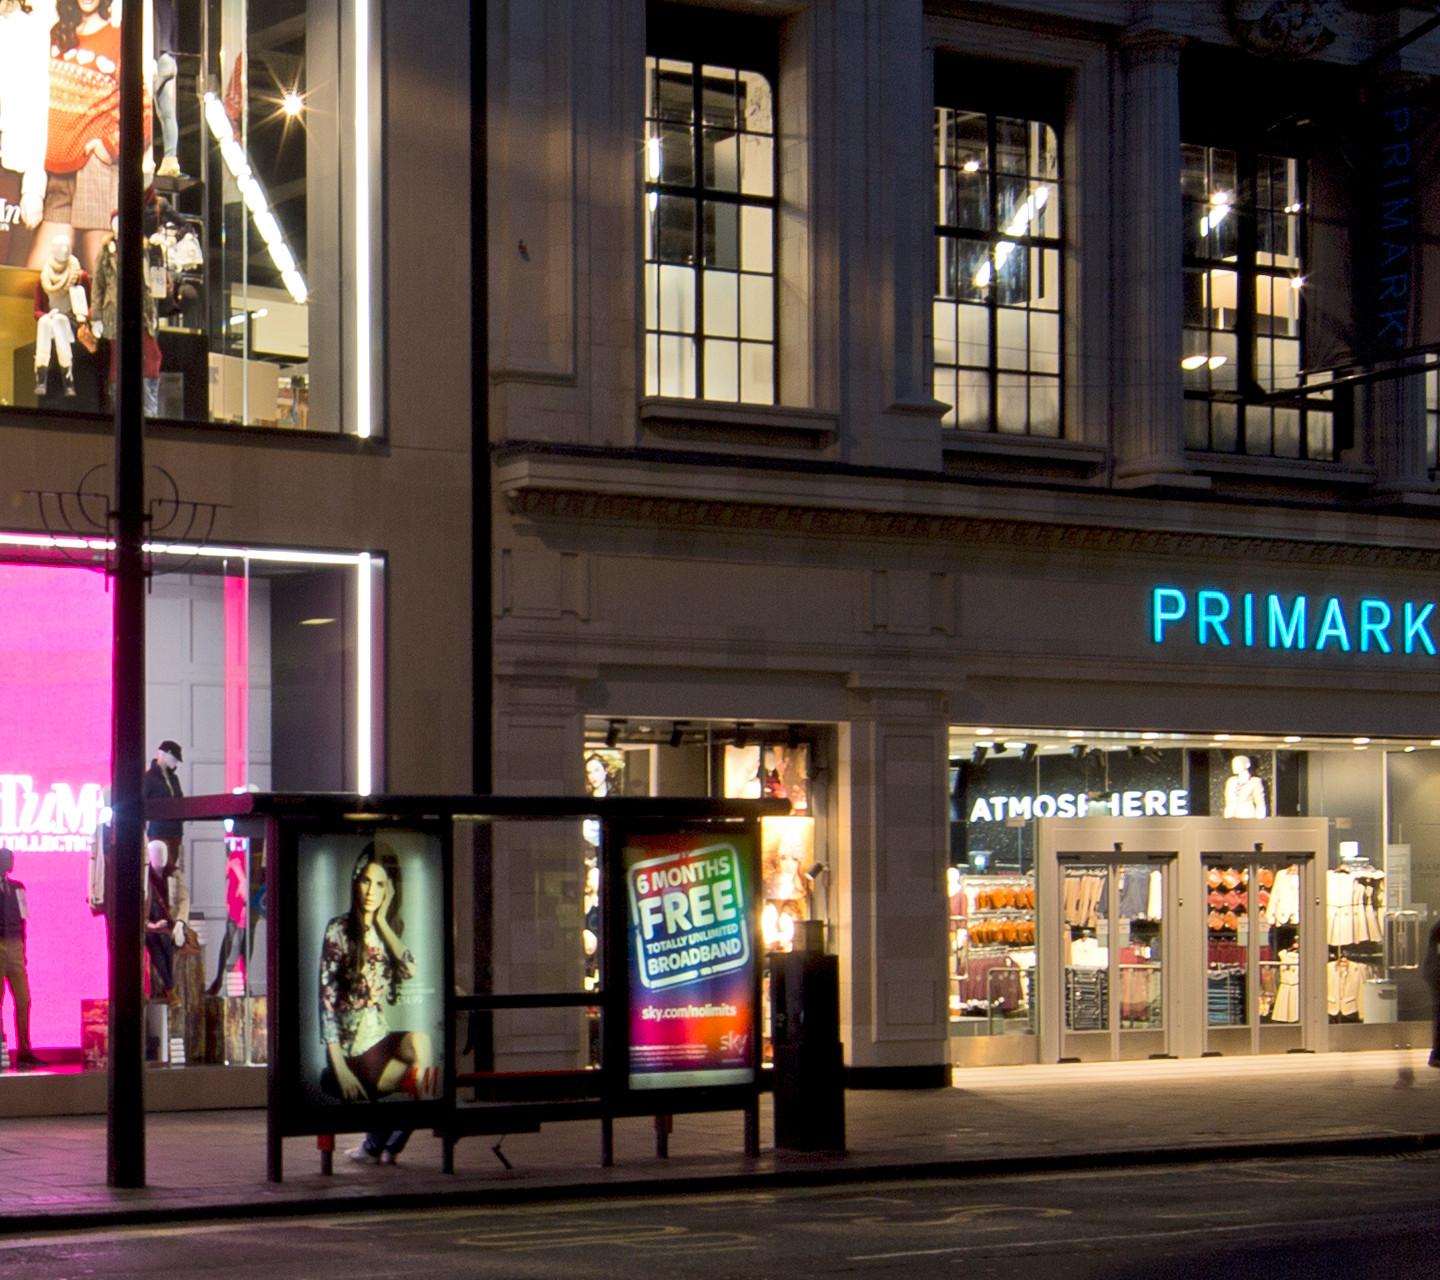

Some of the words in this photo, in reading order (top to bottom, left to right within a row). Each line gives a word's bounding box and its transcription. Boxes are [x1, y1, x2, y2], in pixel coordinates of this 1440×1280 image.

[1152, 587, 1439, 656] PRIMARK
[636, 873, 650, 895] 6
[651, 855, 731, 892] MONTHS
[638, 878, 738, 941] FREE
[646, 934, 688, 955] TOTALLY
[687, 922, 739, 946] UNLIMITED
[647, 937, 742, 976] BROADBAND
[641, 1002, 737, 1023] sky.com/nolimits
[719, 1029, 749, 1055] sky
